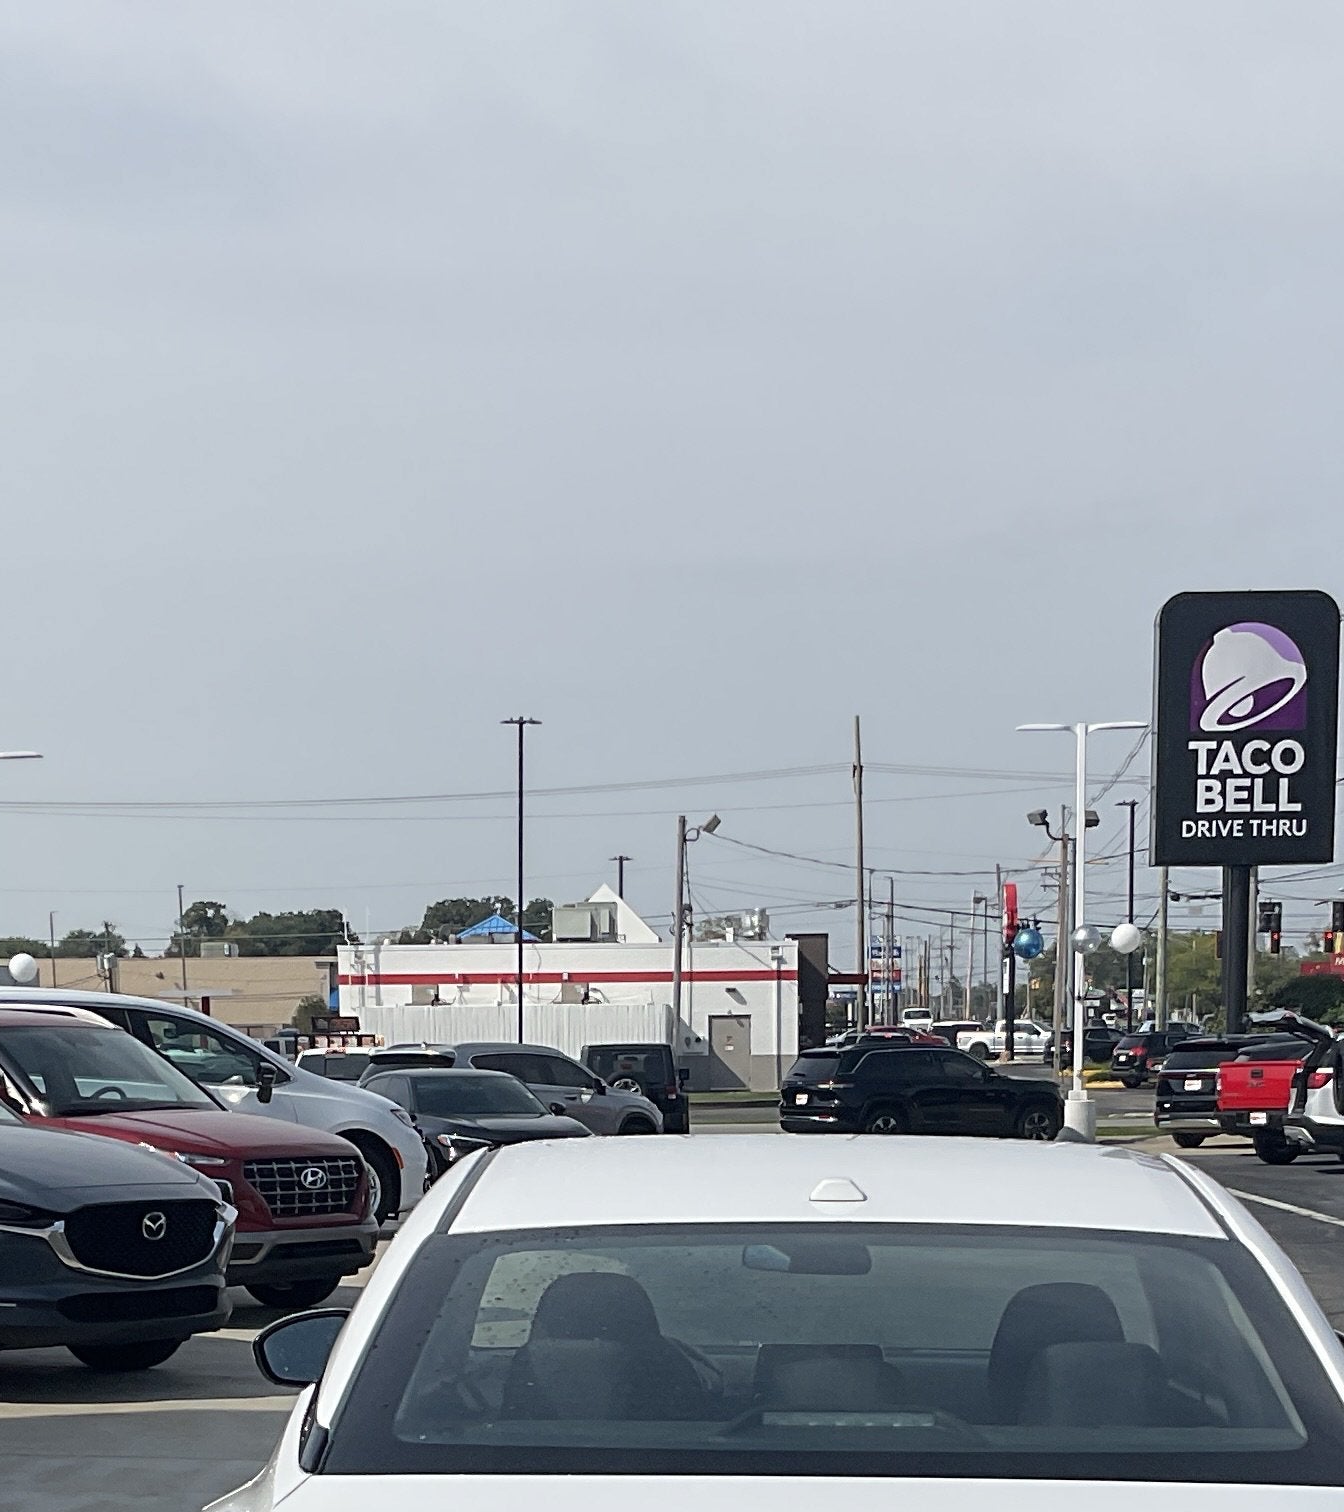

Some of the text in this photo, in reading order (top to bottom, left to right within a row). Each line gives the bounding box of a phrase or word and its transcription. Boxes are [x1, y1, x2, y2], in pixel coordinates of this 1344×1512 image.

[1188, 739, 1305, 775] TACO
[1196, 777, 1301, 813] BELL
[1181, 819, 1307, 837] DRIVE THRU
